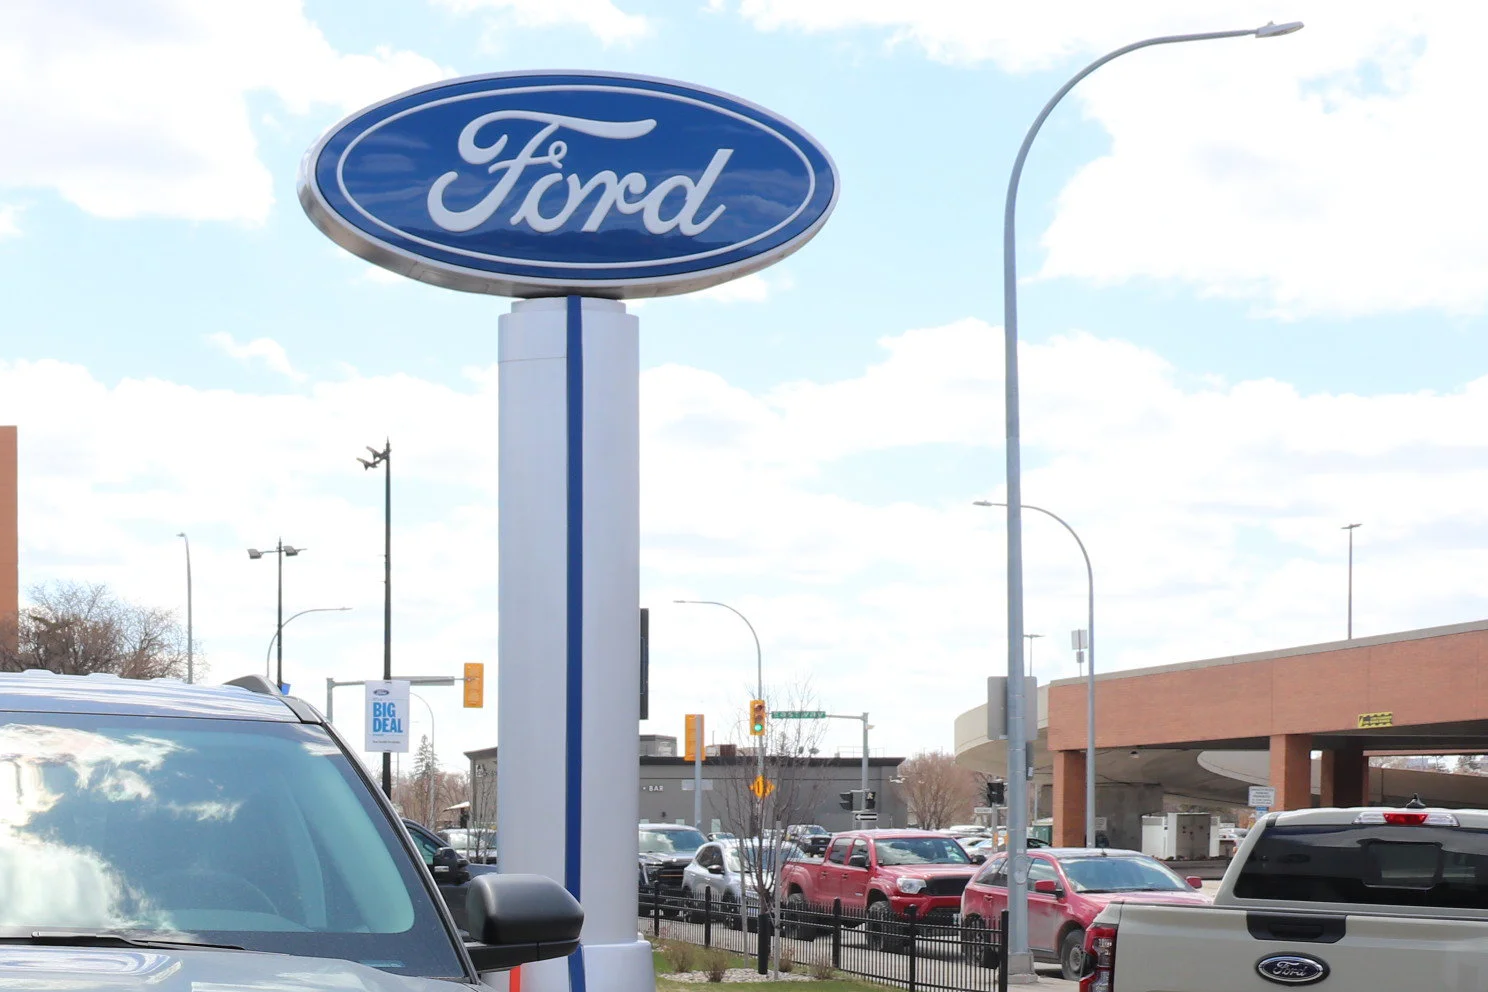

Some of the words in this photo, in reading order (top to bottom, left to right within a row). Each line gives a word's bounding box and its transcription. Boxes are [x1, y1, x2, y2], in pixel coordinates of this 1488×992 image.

[427, 110, 734, 237] Ford
[373, 702, 396, 717] BIG
[373, 718, 403, 732] DEAL
[1272, 961, 1308, 977] Ford
